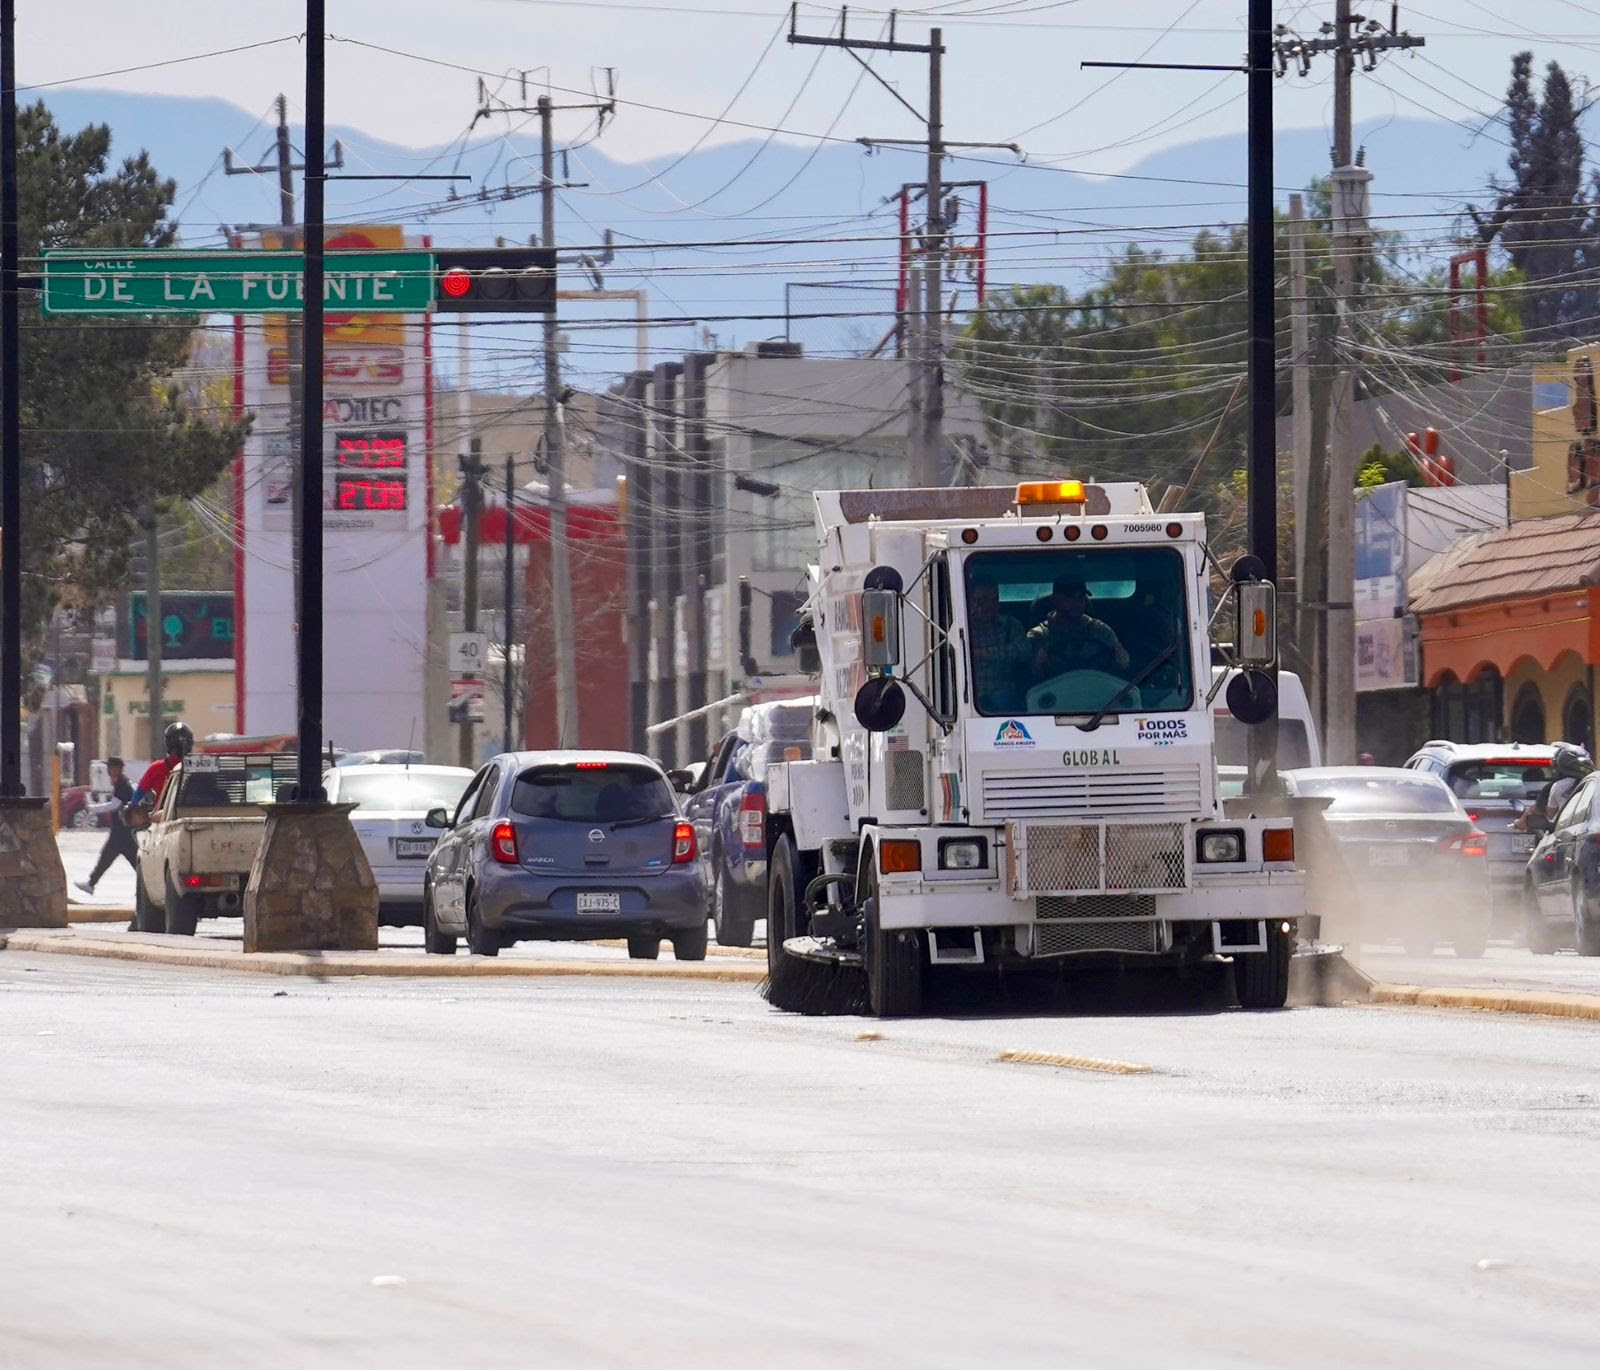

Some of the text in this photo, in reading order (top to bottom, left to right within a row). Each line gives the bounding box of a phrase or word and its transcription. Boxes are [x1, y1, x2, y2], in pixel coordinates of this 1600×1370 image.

[84, 259, 136, 269] CALLE
[84, 273, 135, 300] DE
[164, 273, 215, 300] LA
[1123, 523, 1162, 532] 7005980
[458, 642, 479, 657] 40
[1138, 728, 1188, 741] POR MÁS
[1062, 750, 1120, 767] GLOBAL
